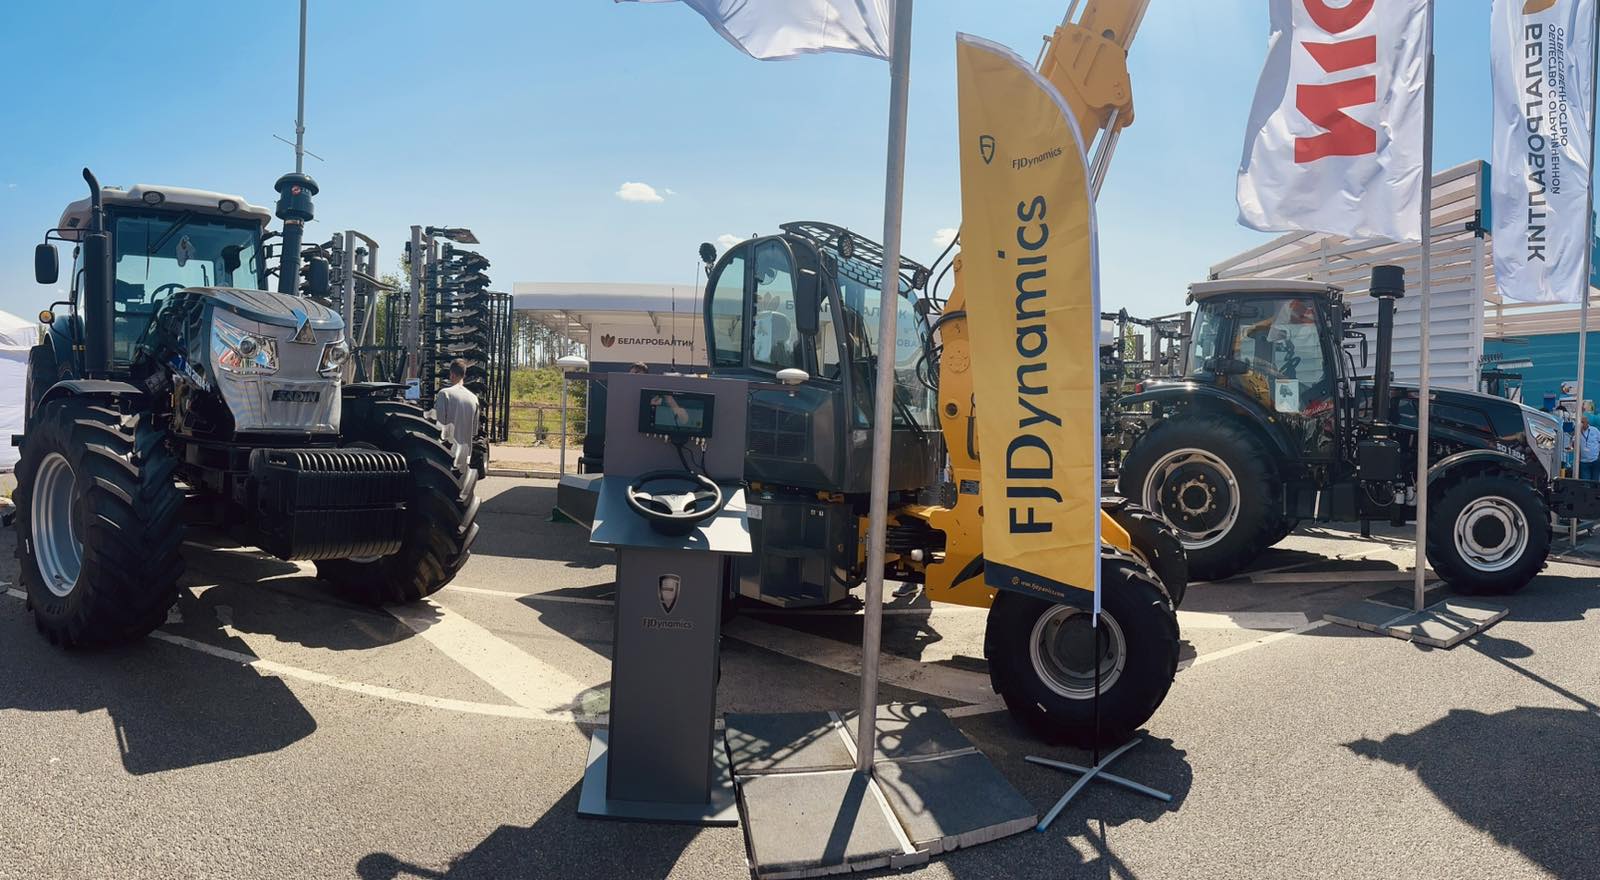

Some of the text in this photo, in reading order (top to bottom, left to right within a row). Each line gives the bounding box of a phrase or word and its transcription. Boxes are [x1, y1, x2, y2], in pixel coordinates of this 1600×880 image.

[1012, 147, 1063, 170] FJDynamics
[997, 195, 1063, 534] FJDynamics
[642, 617, 692, 629] FJDynamics
